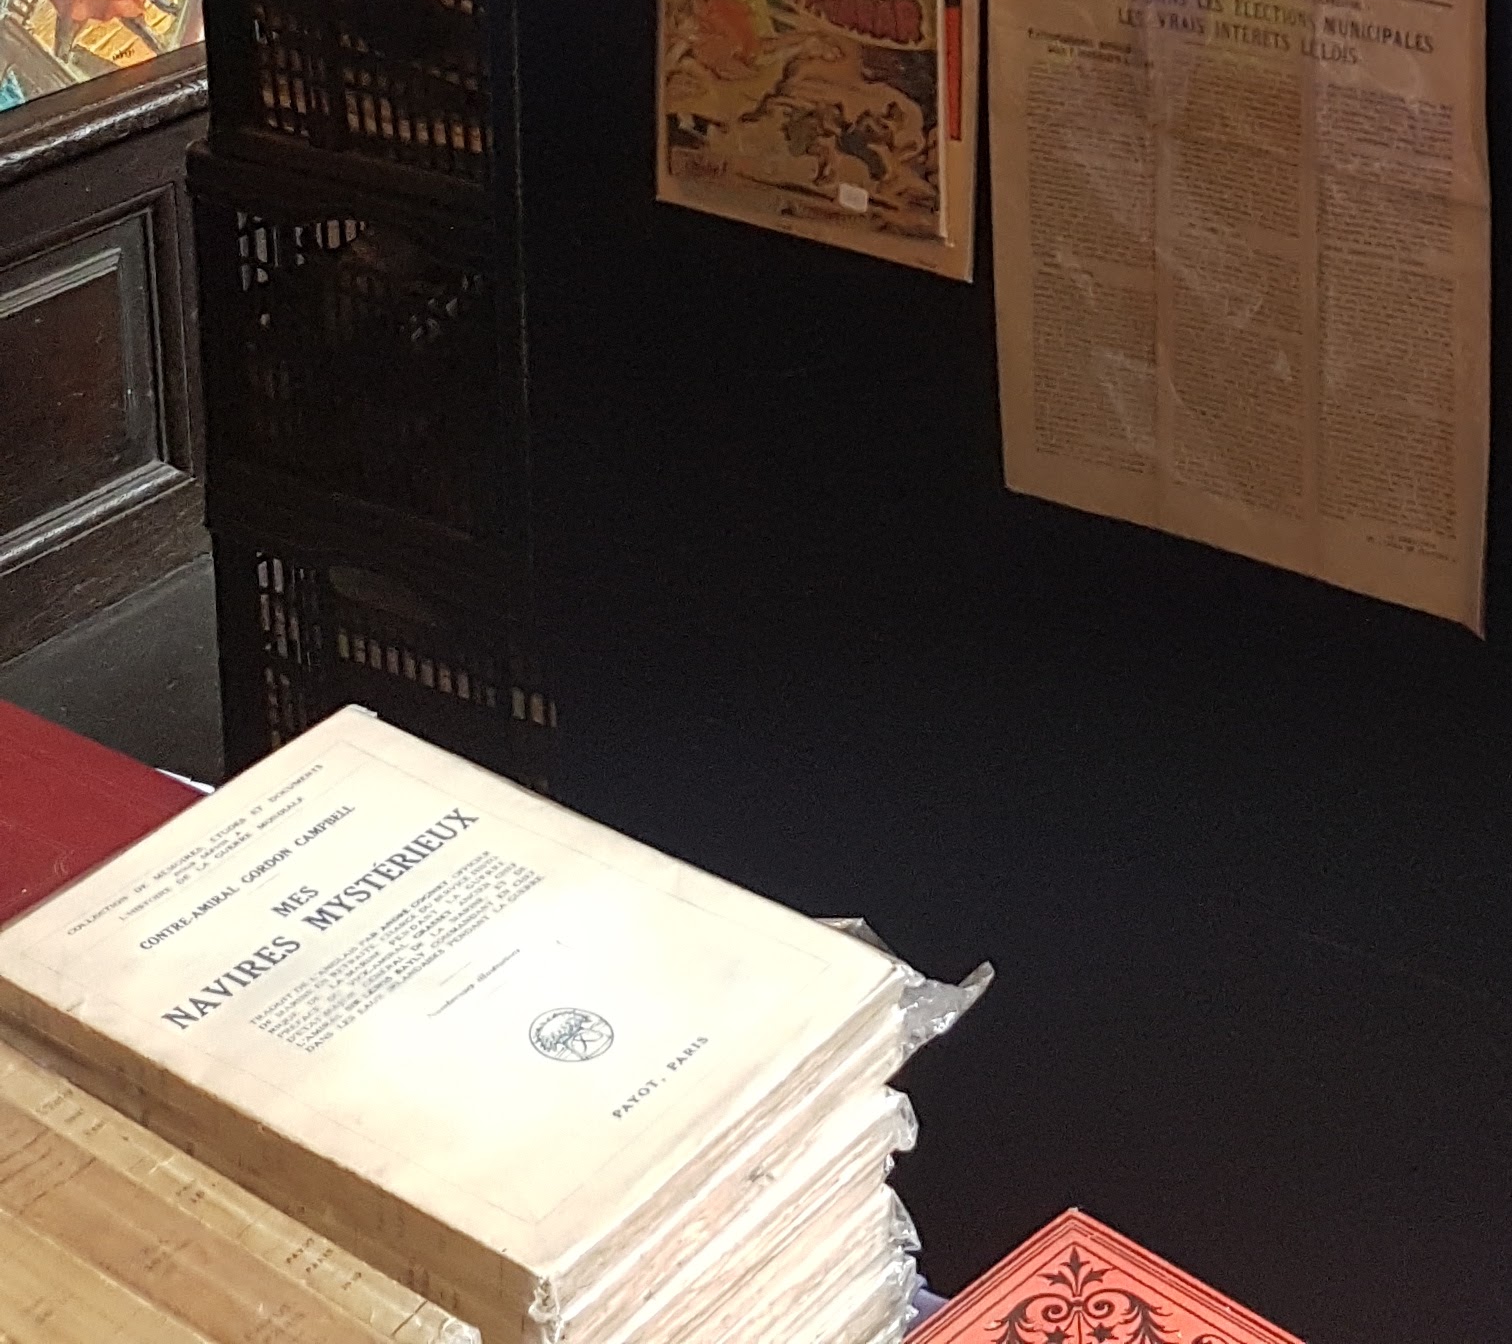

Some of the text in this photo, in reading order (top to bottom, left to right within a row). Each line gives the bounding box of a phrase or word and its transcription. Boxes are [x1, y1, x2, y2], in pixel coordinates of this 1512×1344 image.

[1323, 16, 1435, 55] MUNICIPALES
[139, 804, 356, 951] CONTRE-AMIRAL GORDON CAMPBELL
[161, 934, 302, 1031] NAVIRES
[302, 806, 479, 933] MYSTÉRIEUX
[271, 885, 320, 919] MES
[667, 1034, 710, 1073] PARIS
